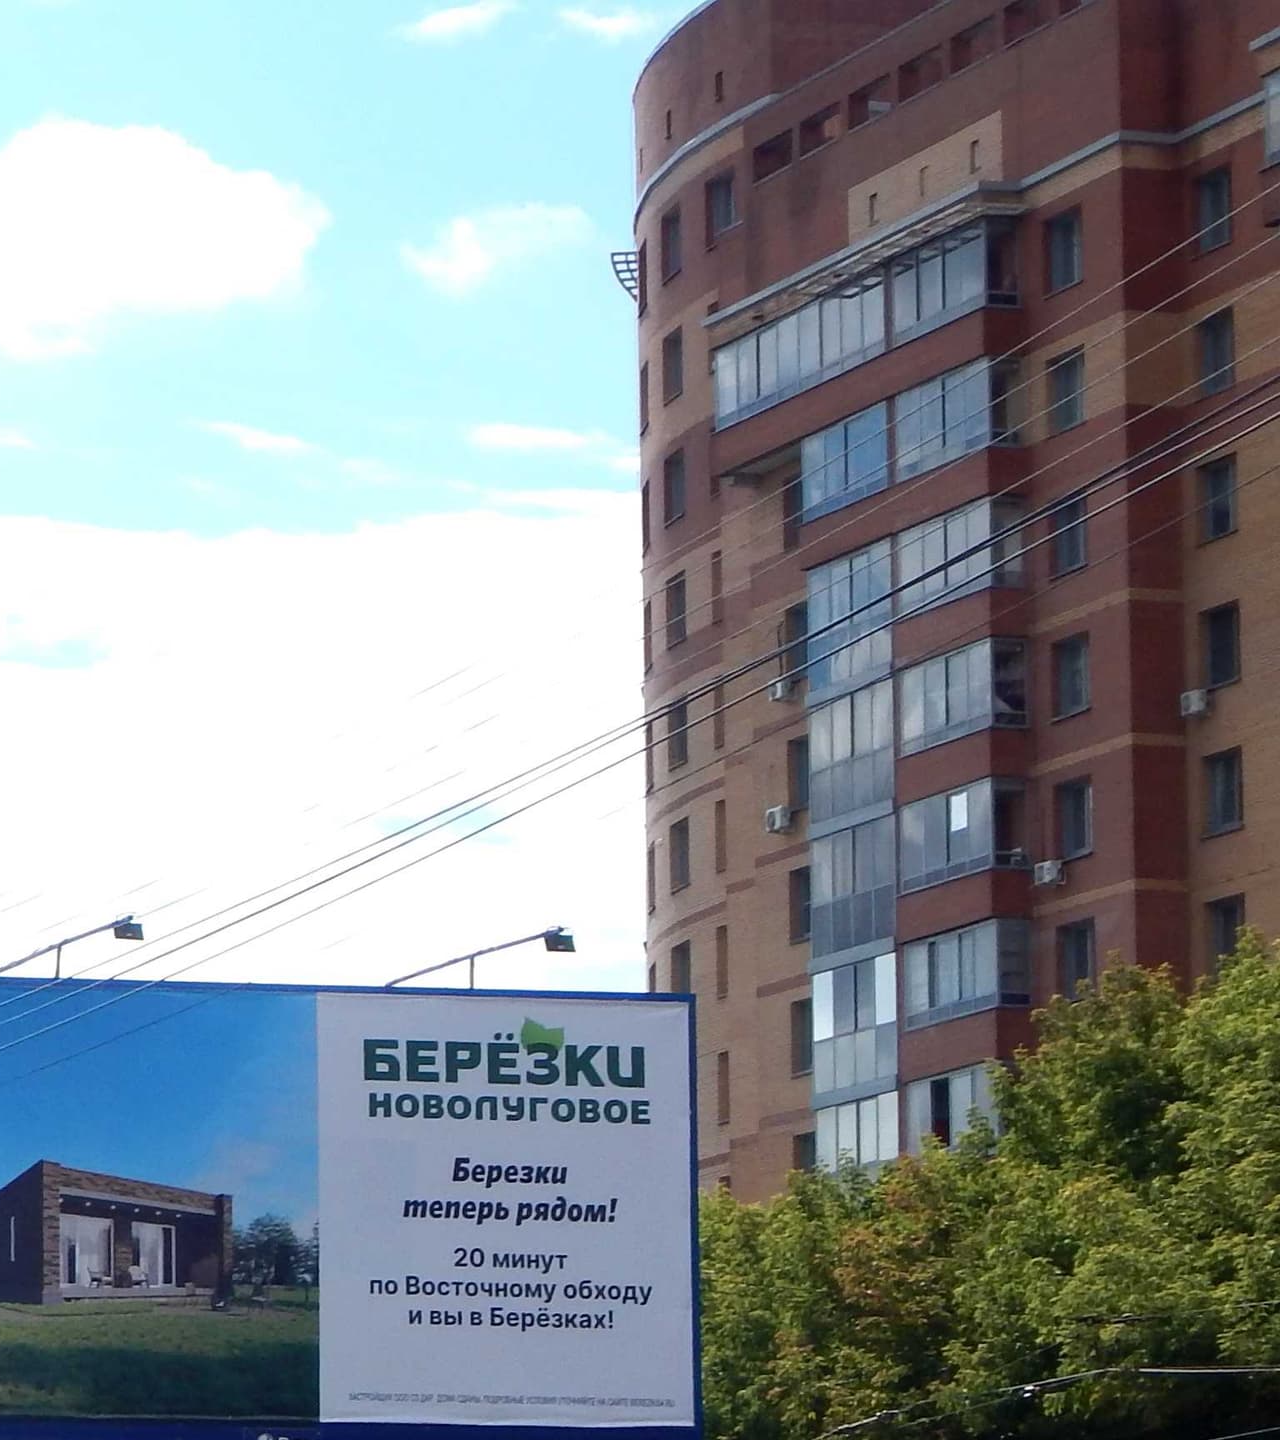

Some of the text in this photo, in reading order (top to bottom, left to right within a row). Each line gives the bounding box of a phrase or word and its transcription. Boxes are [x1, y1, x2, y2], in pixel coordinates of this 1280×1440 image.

[363, 1032, 646, 1088] БЕРЁЗКИ
[368, 1092, 651, 1125] НОВОЛУГОВОЕ
[452, 1157, 568, 1188] Березки
[402, 1196, 618, 1226] теперь рядом!
[453, 1247, 568, 1274] 20 минут
[369, 1275, 652, 1305] по Восточному обходу
[408, 1307, 614, 1332] и вы в Берёзках!
